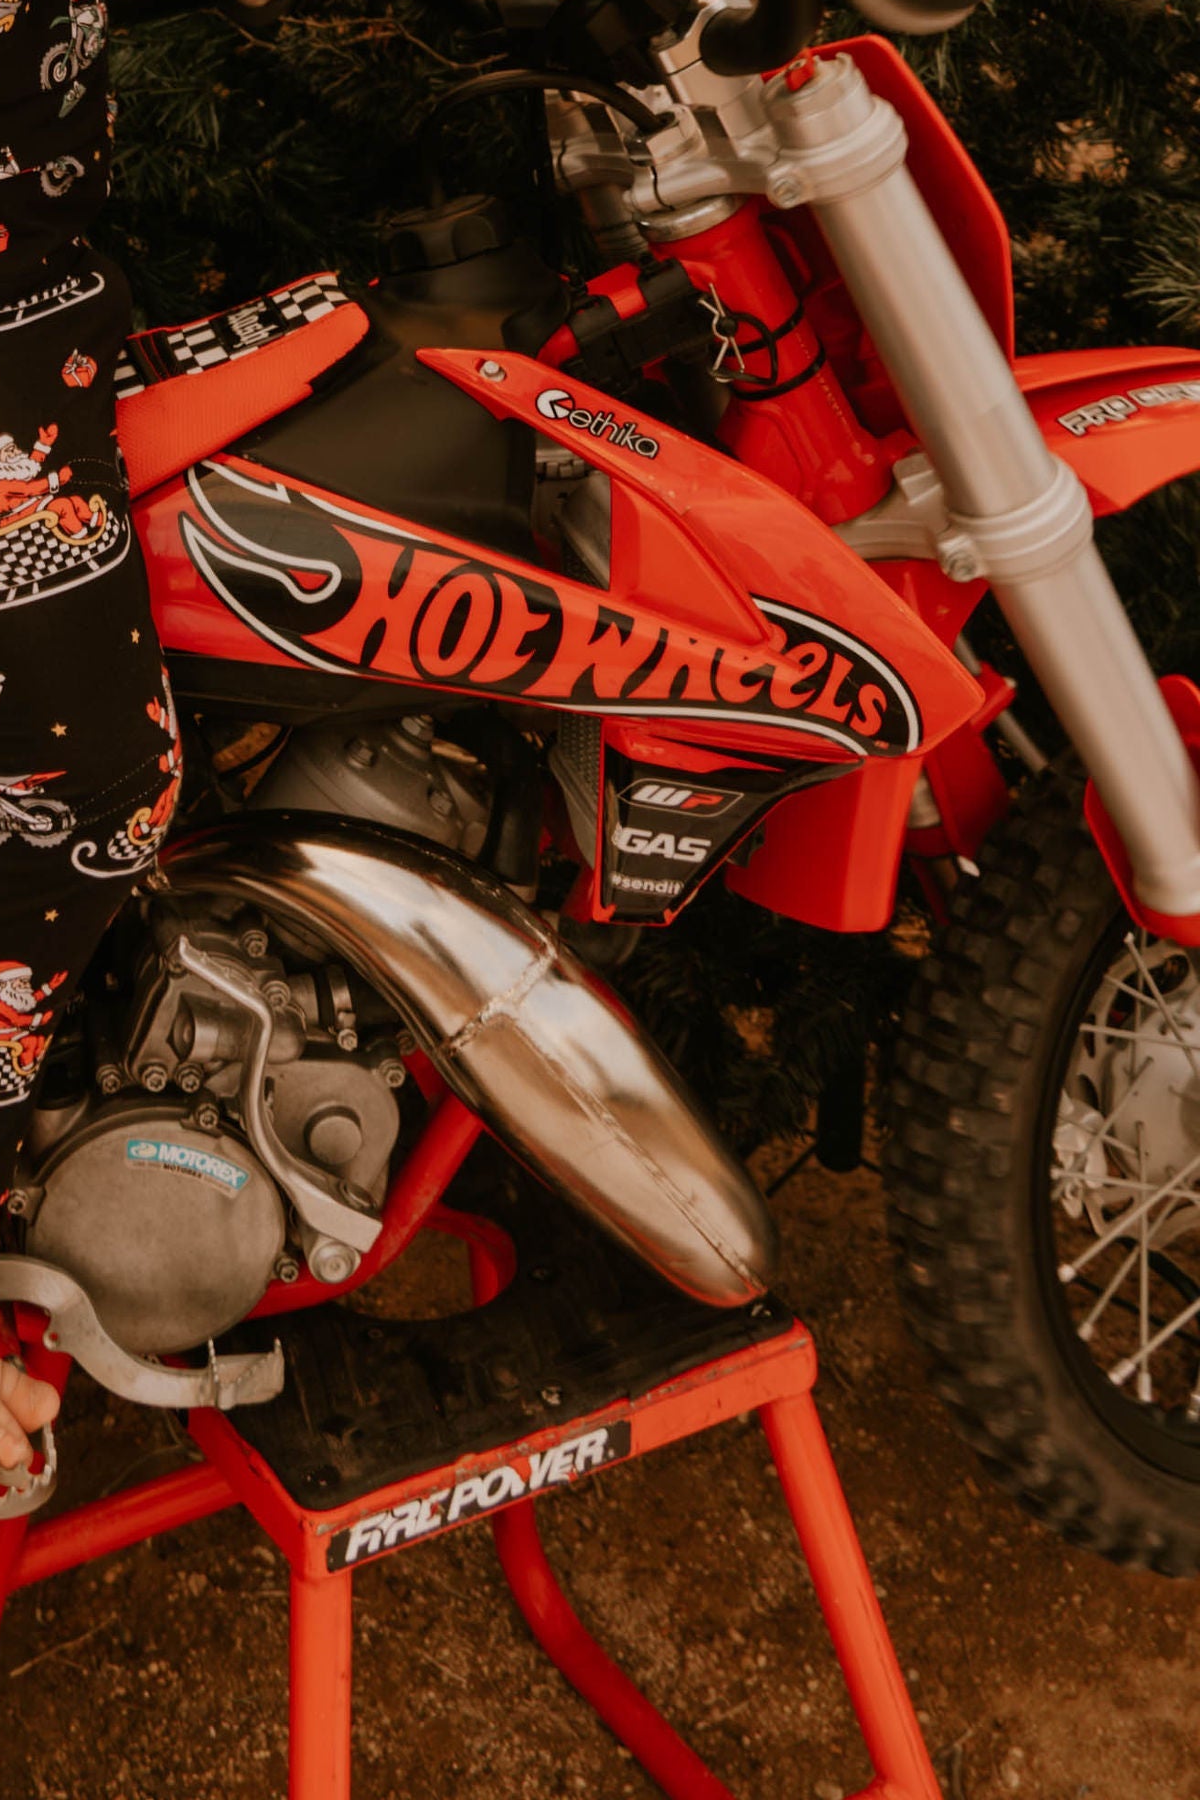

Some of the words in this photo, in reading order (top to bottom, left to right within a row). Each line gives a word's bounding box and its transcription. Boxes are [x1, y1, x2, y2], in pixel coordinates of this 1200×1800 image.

[568, 410, 660, 459] ethika
[1057, 395, 1138, 437] PRO
[632, 785, 724, 809] WP
[158, 1143, 246, 1187] MOTOREX
